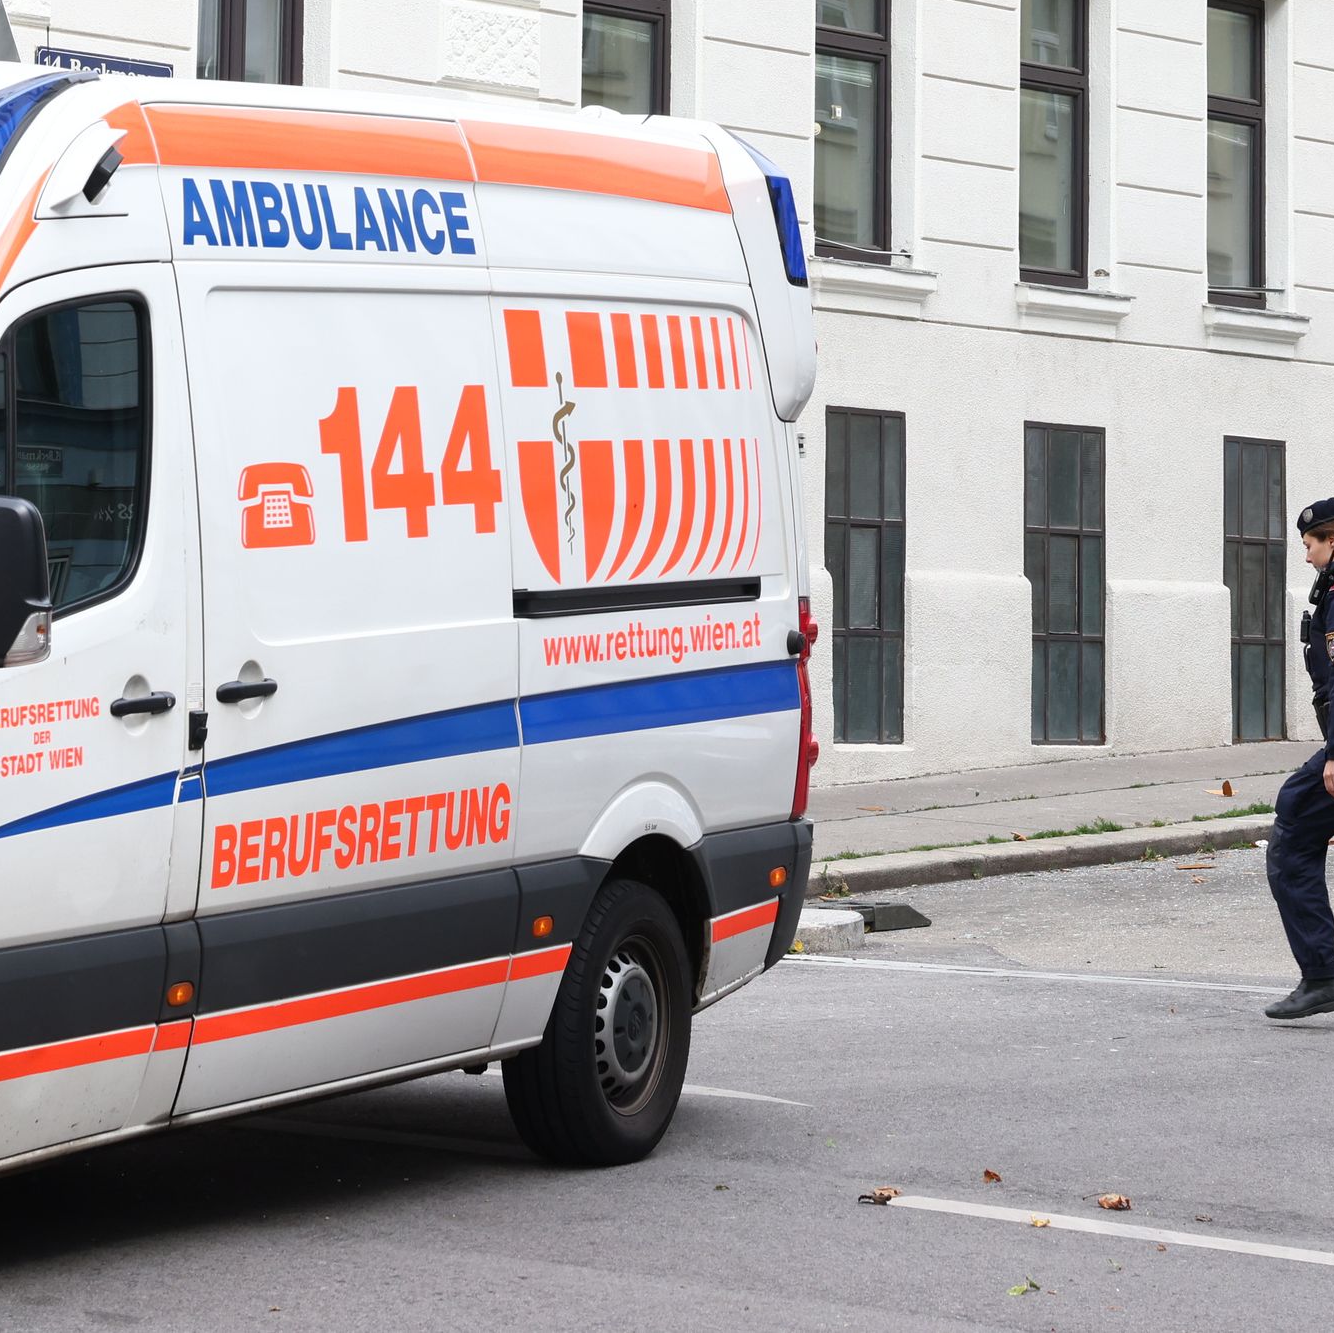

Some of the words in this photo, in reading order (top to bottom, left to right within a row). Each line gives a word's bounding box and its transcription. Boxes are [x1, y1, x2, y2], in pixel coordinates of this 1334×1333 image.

[182, 177, 477, 256] AMBULANCE
[318, 384, 503, 542] 144
[543, 611, 762, 667] www.rettung.wien.at
[0, 751, 44, 778] STADT
[49, 746, 83, 771] WIEN
[33, 730, 52, 745] DER
[210, 782, 512, 890] BERUFSRETTUNG
